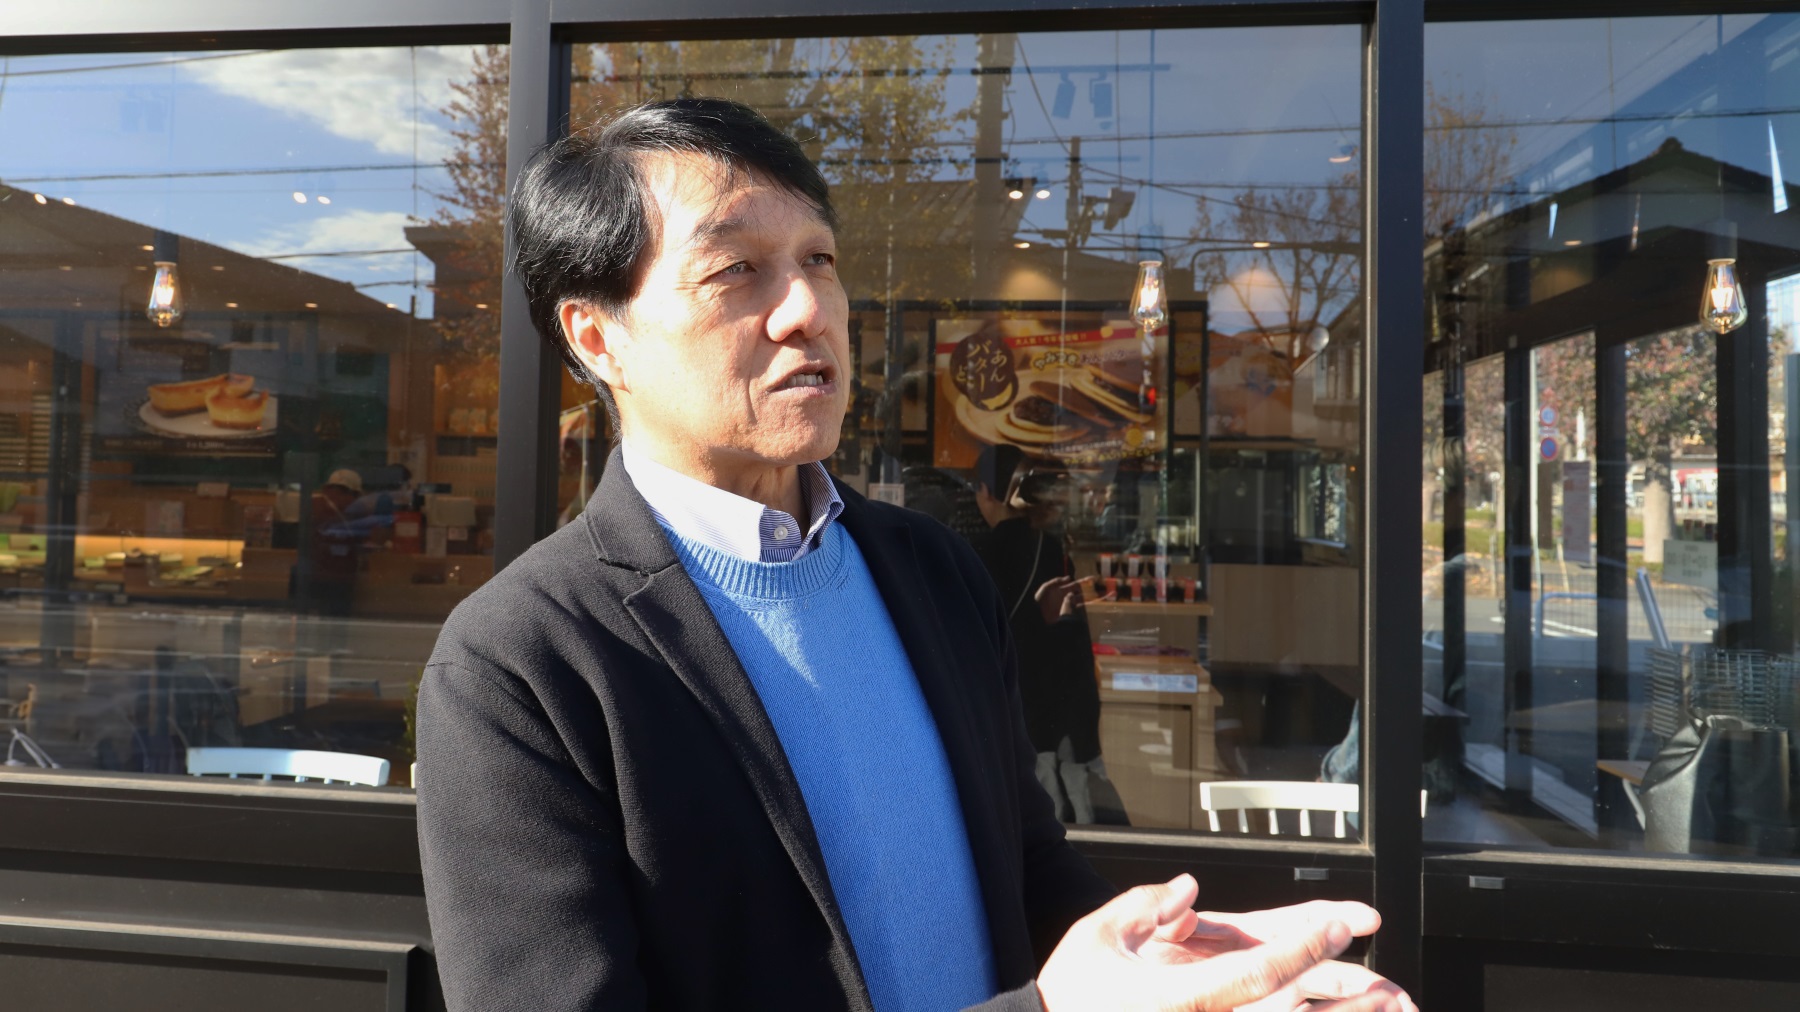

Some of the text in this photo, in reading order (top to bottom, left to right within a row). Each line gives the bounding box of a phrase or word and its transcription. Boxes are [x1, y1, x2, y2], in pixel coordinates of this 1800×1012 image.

[966, 339, 992, 393] バター
[990, 348, 1007, 383] あん
